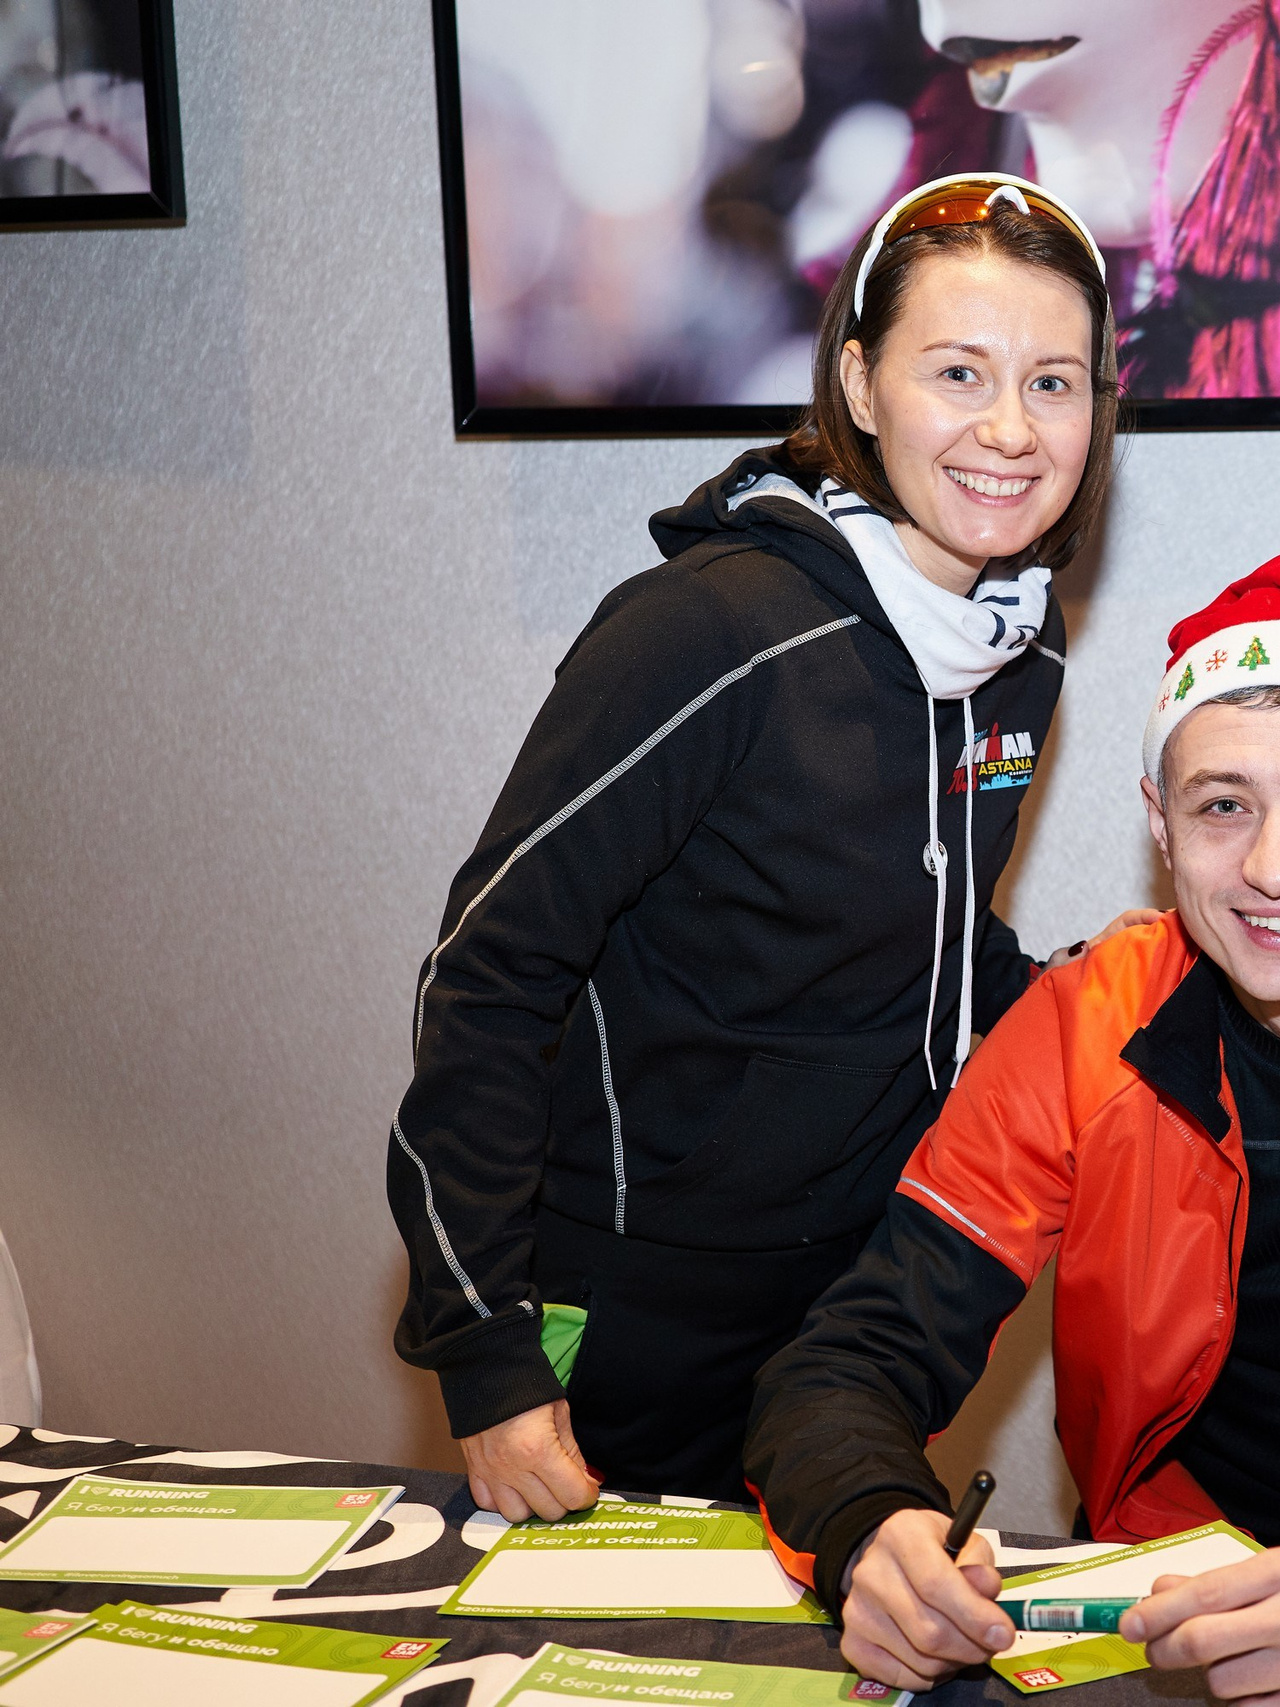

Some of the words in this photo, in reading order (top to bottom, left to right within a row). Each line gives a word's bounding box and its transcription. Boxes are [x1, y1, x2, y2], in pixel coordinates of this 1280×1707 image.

[978, 757, 1034, 776] ASTANA
[108, 1488, 211, 1500] RUNNING
[64, 1501, 83, 1511] Я
[85, 1504, 135, 1514] бегу
[149, 1505, 237, 1514] обещаю
[550, 1521, 658, 1531] RUNNING
[508, 1537, 527, 1545] Я
[531, 1536, 583, 1547] бегу
[604, 1536, 699, 1545] обещаю
[150, 1611, 259, 1634] RUNNING
[97, 1622, 120, 1633] Я
[118, 1627, 170, 1643] бегу
[187, 1638, 280, 1656] обещаю
[396, 1642, 428, 1651] EM
[585, 1659, 703, 1678] RUNNING
[536, 1672, 558, 1683] Я
[559, 1677, 614, 1693] бегу
[633, 1682, 735, 1701] обещаю
